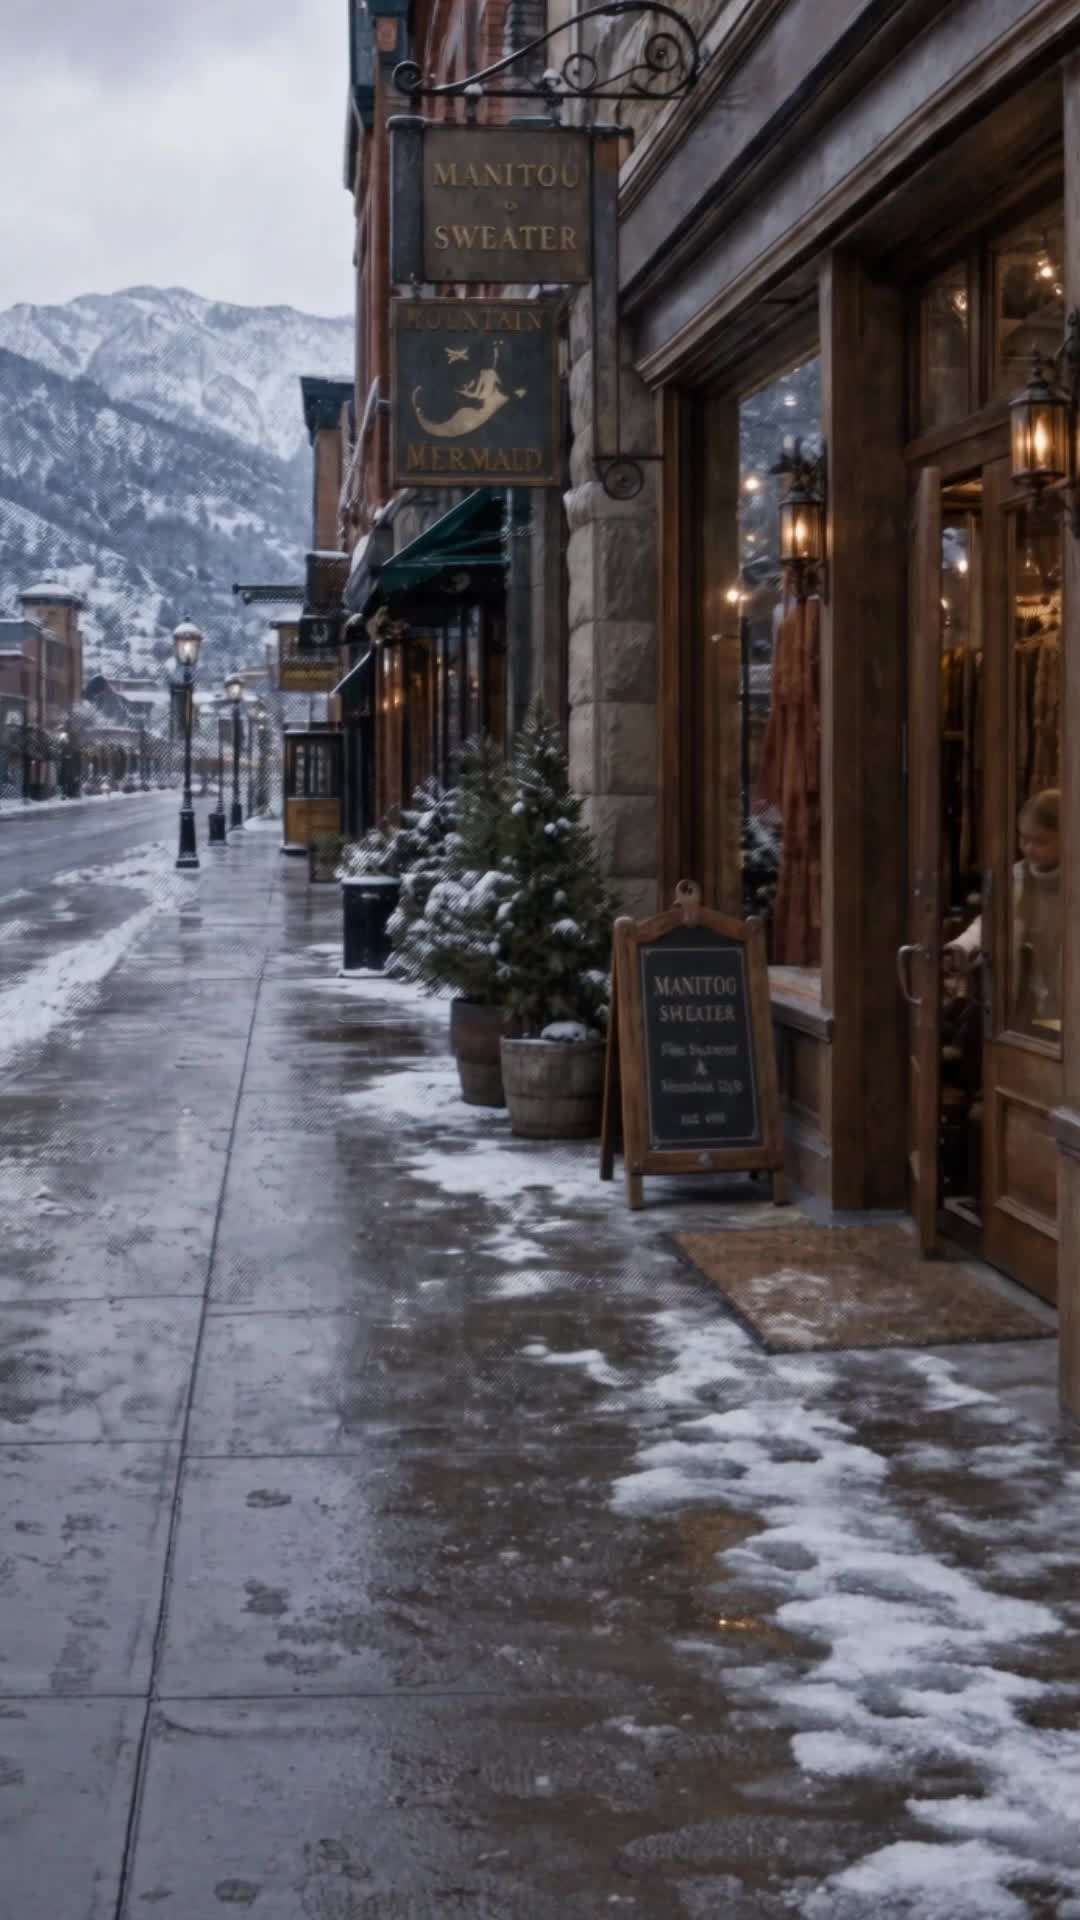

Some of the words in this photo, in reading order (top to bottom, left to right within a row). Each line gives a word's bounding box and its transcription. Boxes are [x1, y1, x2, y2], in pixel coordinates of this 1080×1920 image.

[432, 163, 580, 188] MANITOU
[433, 225, 578, 250] SWEATER
[408, 446, 543, 471] MERMAID
